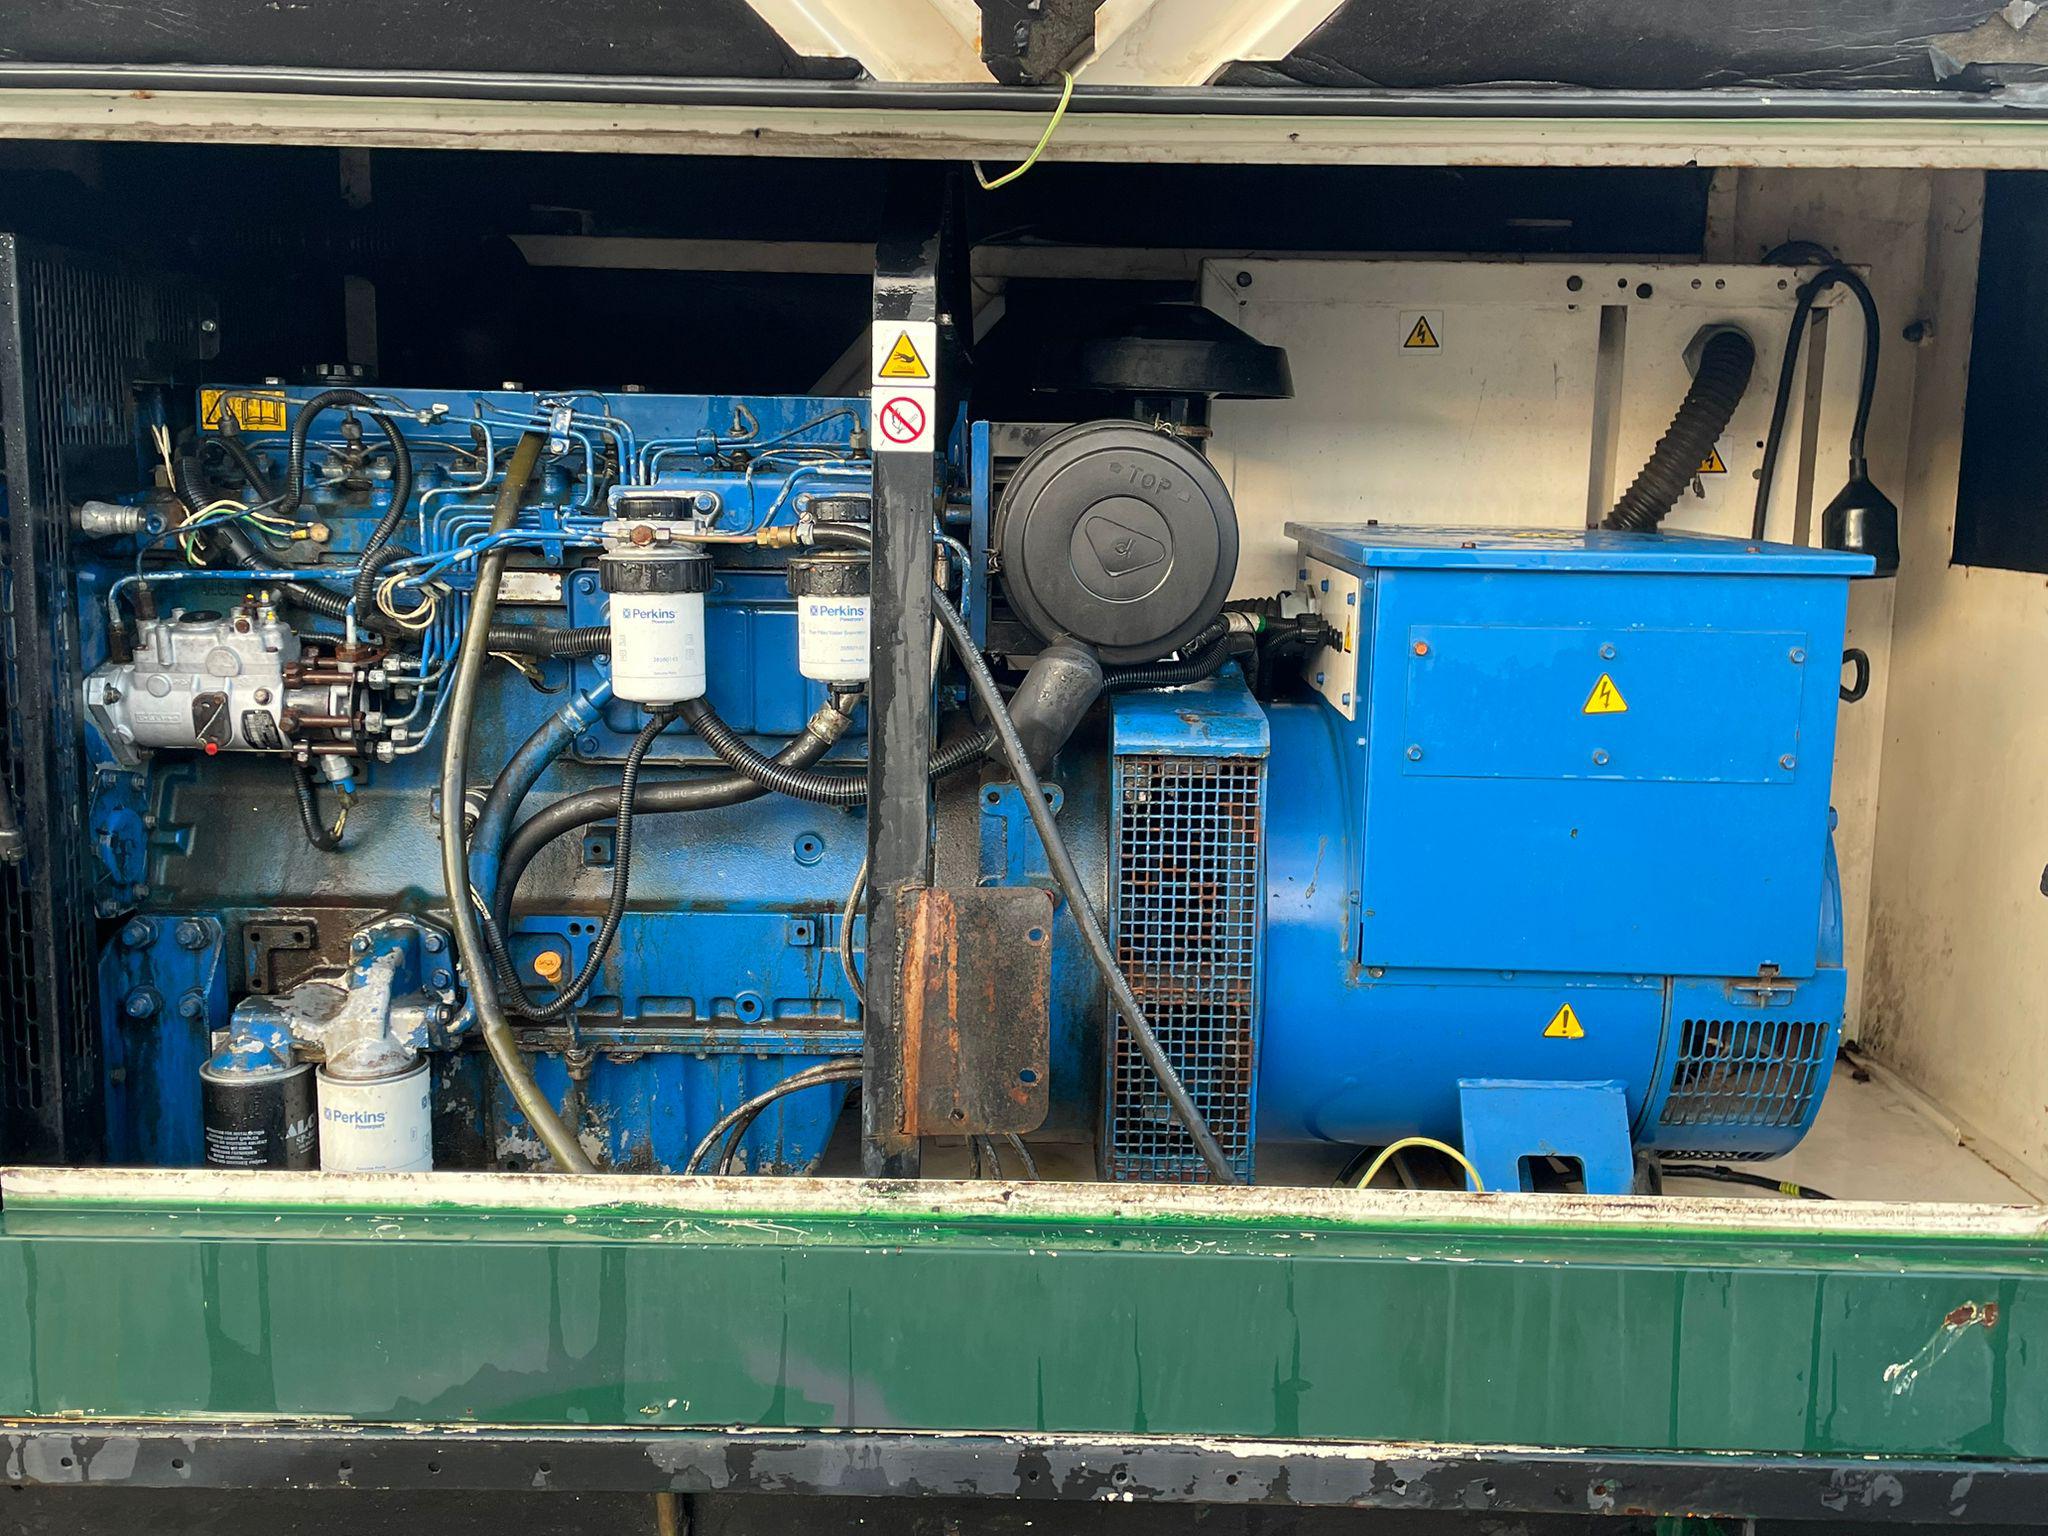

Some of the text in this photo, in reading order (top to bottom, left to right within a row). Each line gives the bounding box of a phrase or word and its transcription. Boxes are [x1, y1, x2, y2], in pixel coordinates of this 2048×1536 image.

[1128, 464, 1172, 496] TOP
[820, 605, 864, 616] Perkins
[934, 586, 961, 623] UNLEADED
[632, 608, 676, 619] Perkins
[958, 623, 971, 640] FOR
[968, 640, 989, 675] SUITABLE
[333, 1109, 386, 1124] Perkins
